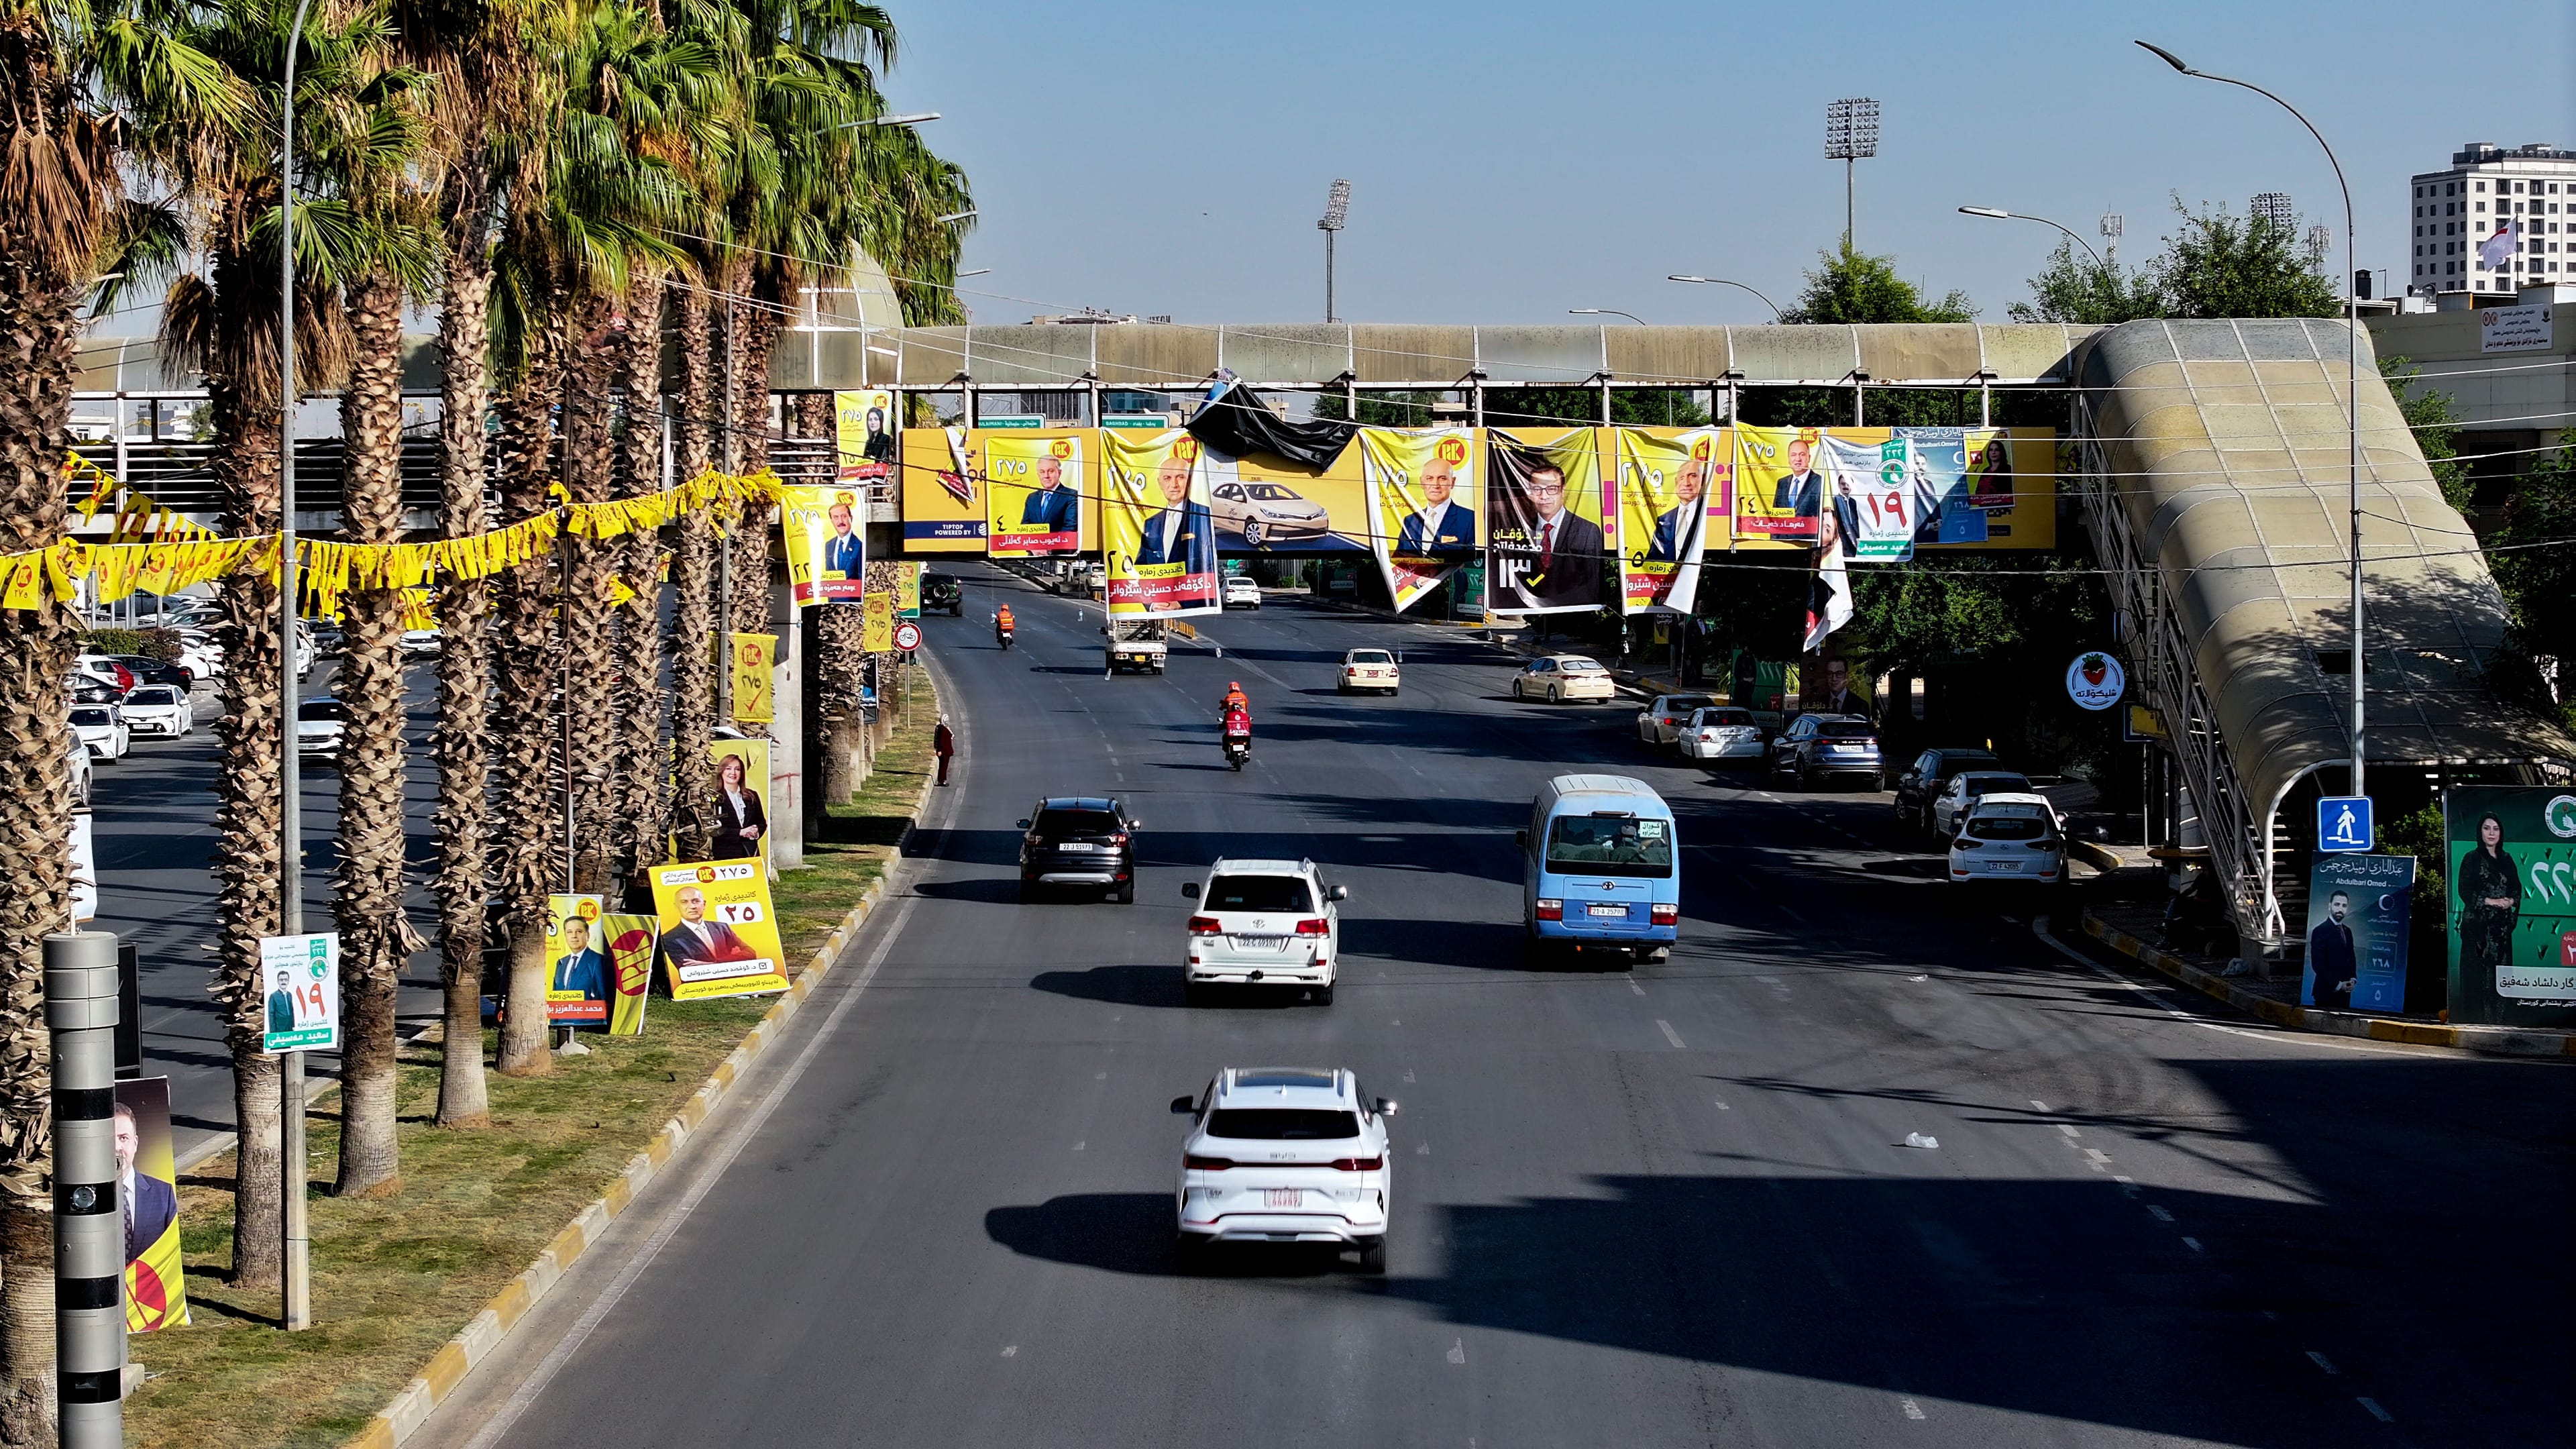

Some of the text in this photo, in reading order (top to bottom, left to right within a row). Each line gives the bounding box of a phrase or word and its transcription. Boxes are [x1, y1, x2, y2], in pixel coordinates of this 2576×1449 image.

[841, 409, 862, 423] ٢٧٥
[1885, 449, 1903, 458] ٢٢٢
[996, 458, 1026, 476] ٢٧٥
[1739, 496, 1758, 515] ٢٤
[1867, 491, 1907, 528] ١٩
[997, 515, 1008, 532] ٤
[1157, 566, 1183, 576] کاندیدی
[1499, 559, 1531, 588] ١٣
[871, 619, 886, 629] ٢٧٥
[741, 674, 761, 689] ٢٧٥
[720, 867, 748, 879] ٢٧٥
[2335, 877, 2387, 888] Abdulbari Omed
[731, 891, 757, 902] کاندیدی
[724, 905, 756, 922] ٢٥
[2372, 957, 2390, 968] ٢٦٨
[2500, 975, 2530, 988] شەفیق
[2532, 977, 2559, 987] دلشاد
[296, 982, 325, 1018] ١٩
[2375, 989, 2381, 1001] ٥
[584, 1004, 603, 1012] محمد
[306, 1030, 329, 1041] سعید
